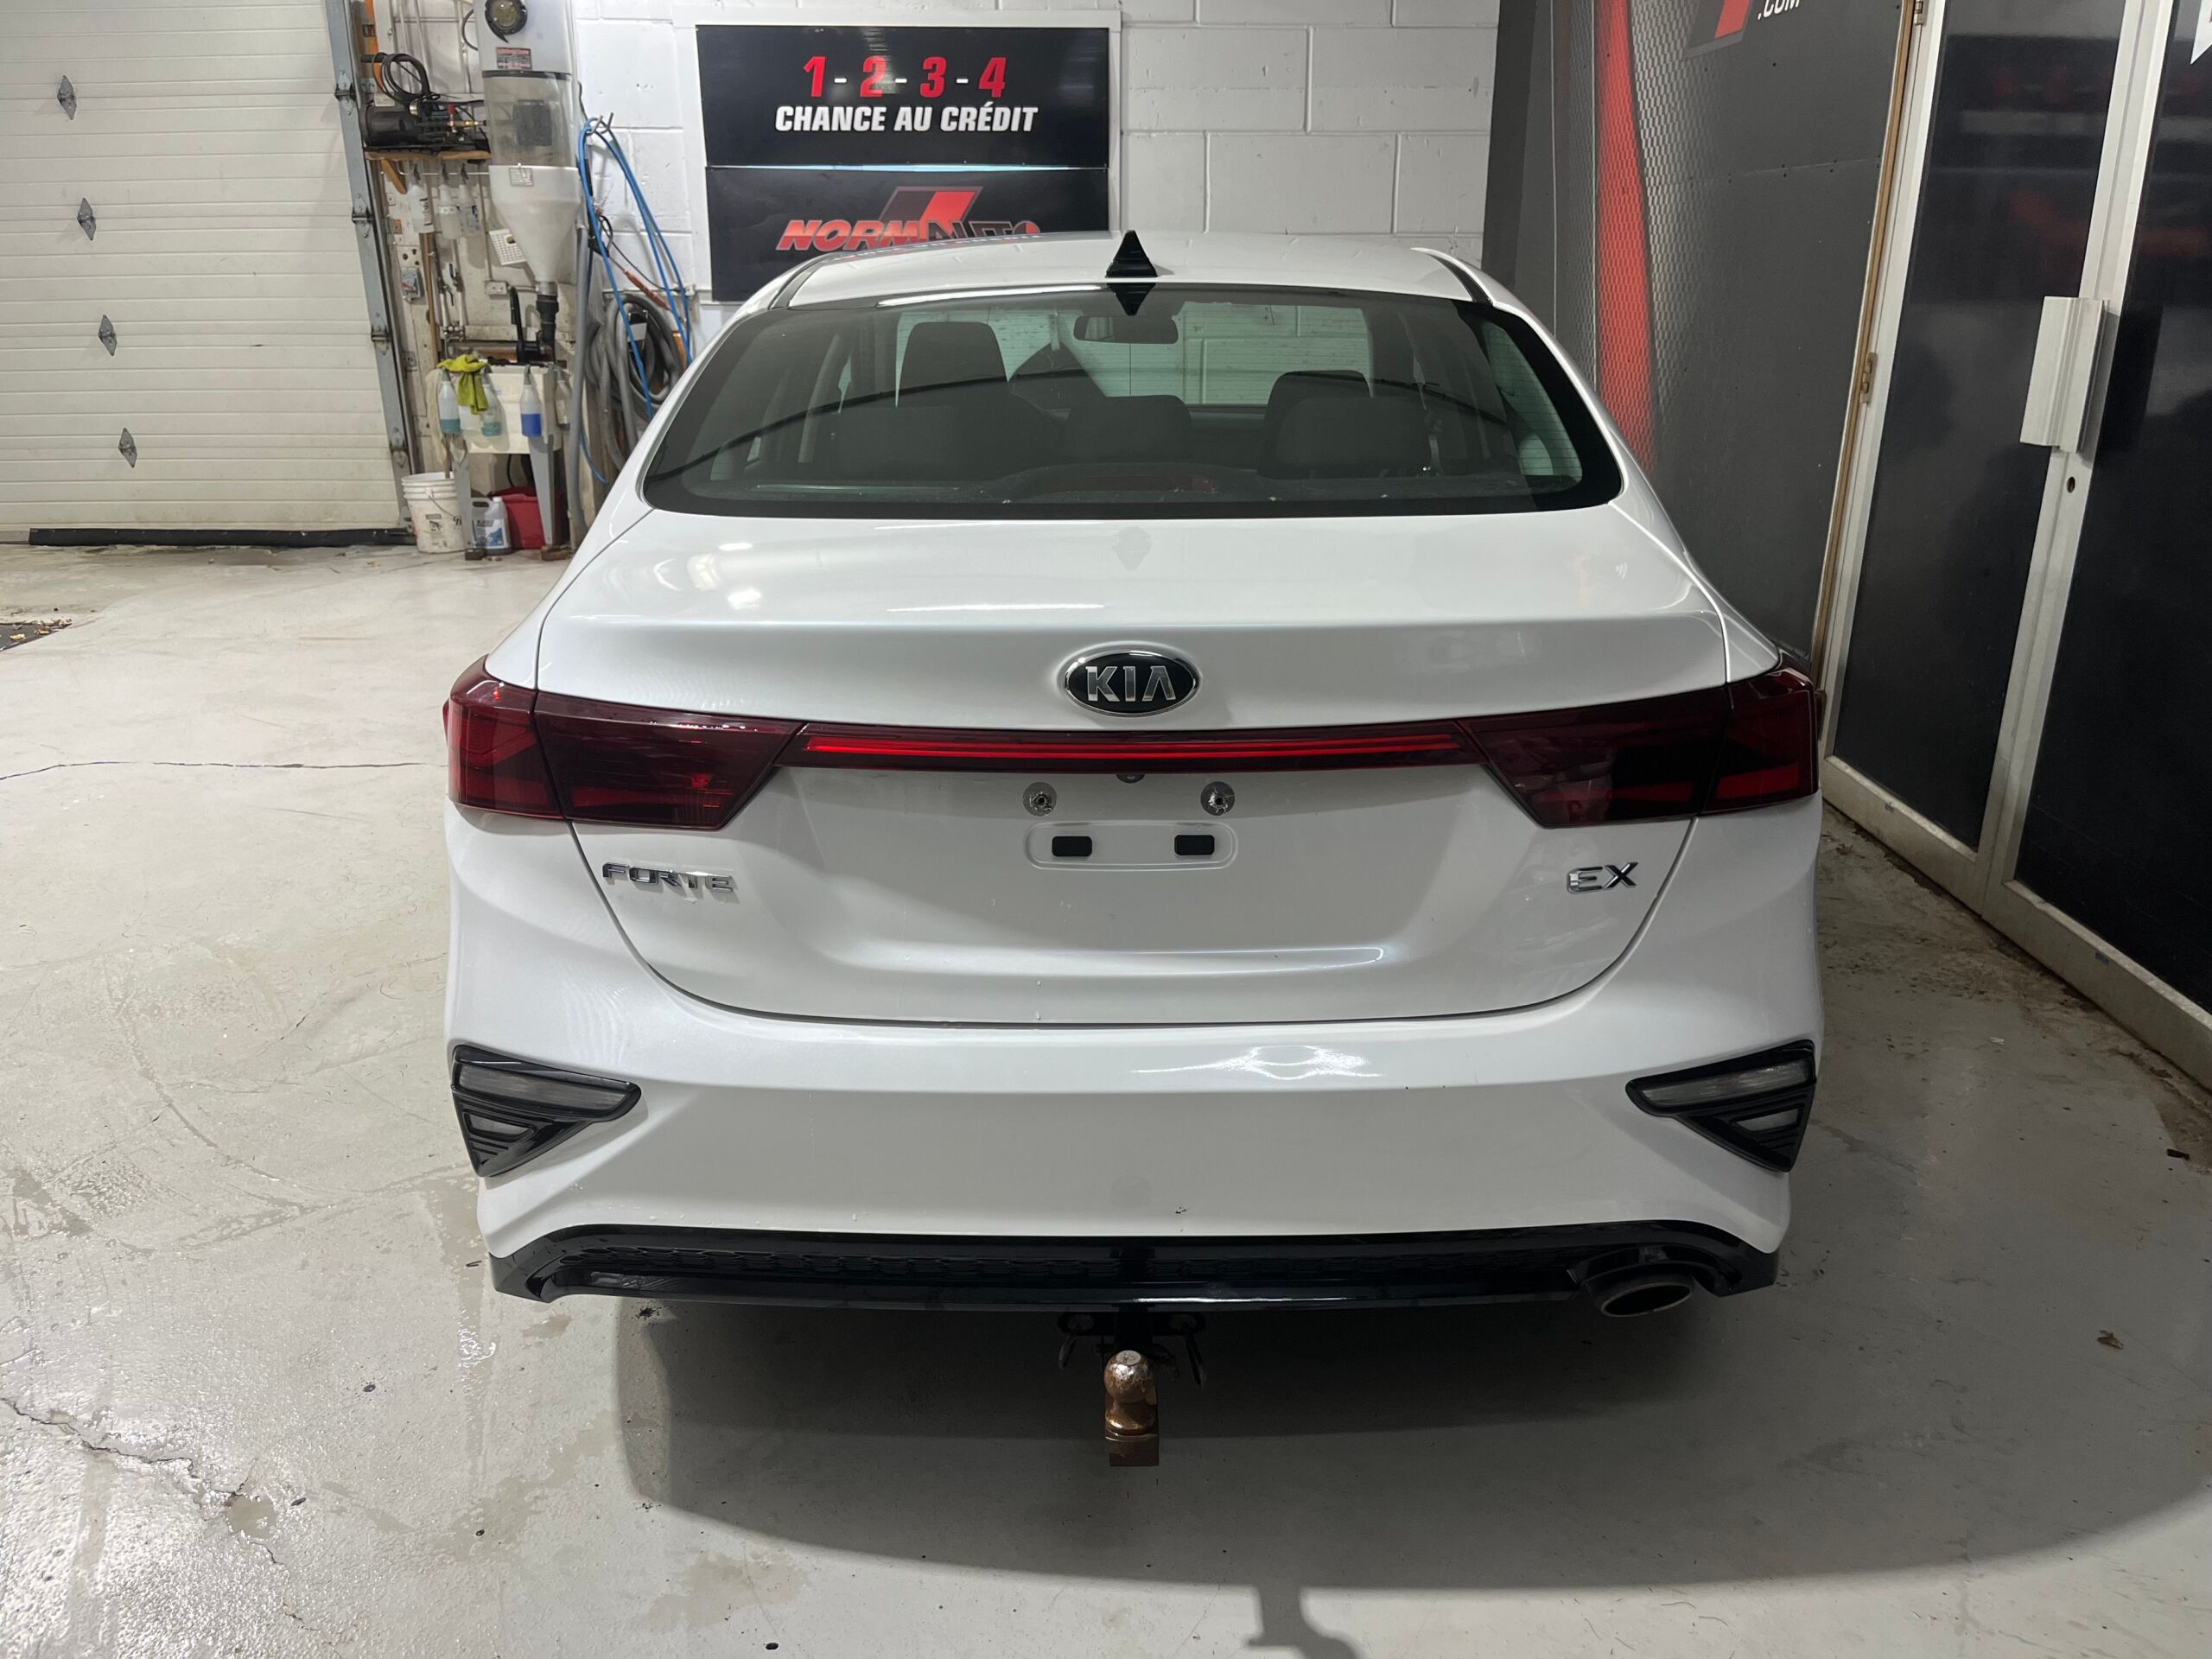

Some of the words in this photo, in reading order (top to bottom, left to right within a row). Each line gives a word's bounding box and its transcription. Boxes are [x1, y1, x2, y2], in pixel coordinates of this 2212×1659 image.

[803, 56, 827, 98] 1
[860, 55, 887, 98] 2
[919, 56, 947, 98] 3
[978, 57, 1007, 98] 4
[775, 105, 887, 131] CHANCE
[893, 106, 932, 131] AU
[940, 101, 1039, 131] CRÉDIT
[1085, 665, 1177, 702] KIA
[602, 862, 734, 893] FORTE
[1567, 861, 1639, 893] EX
